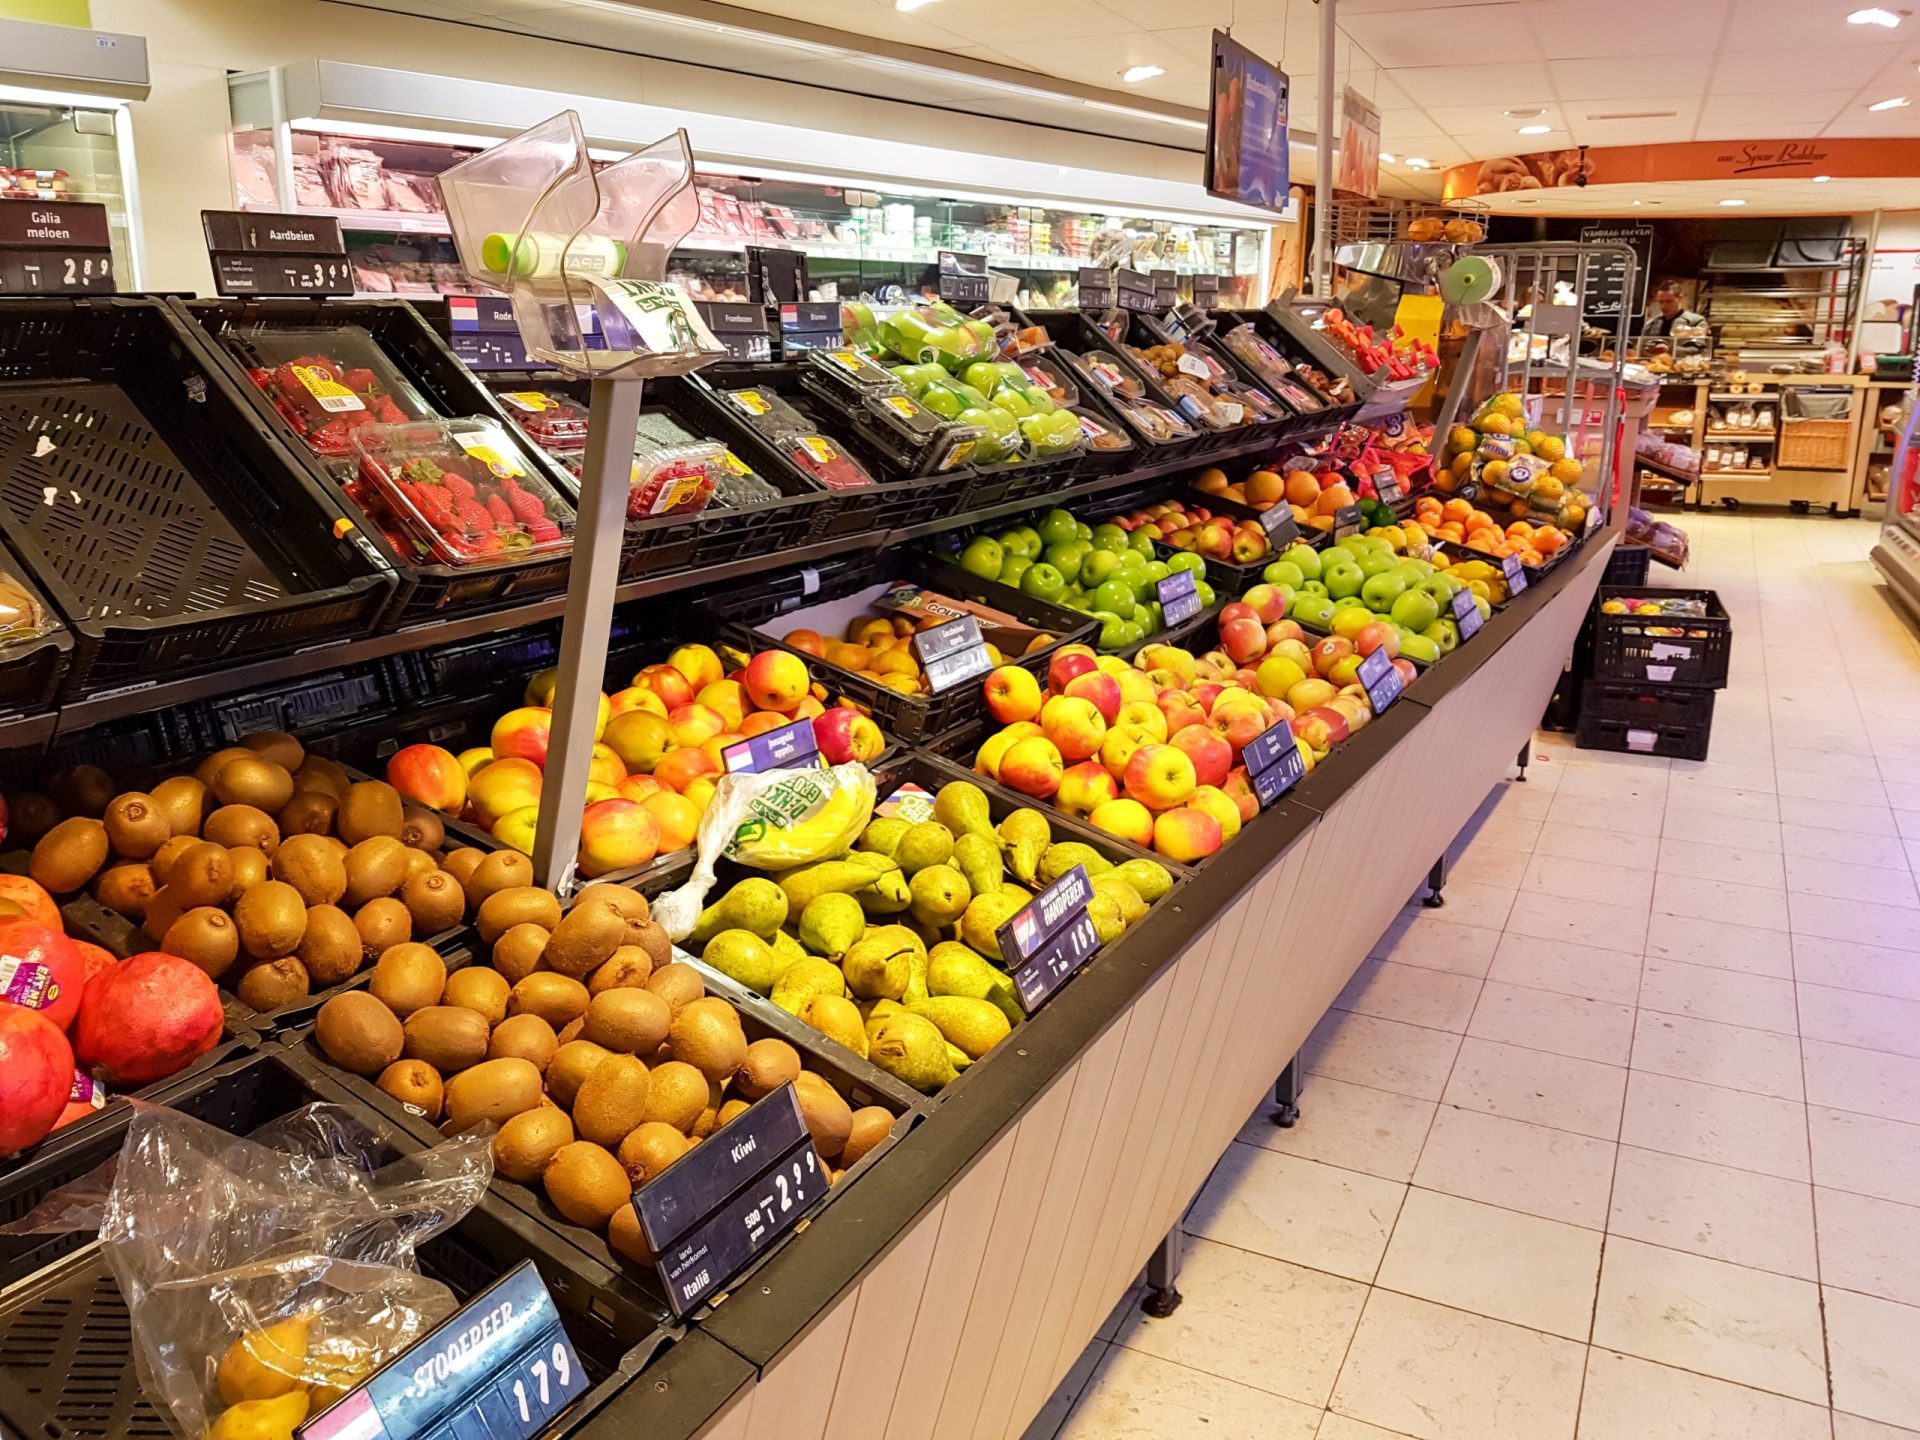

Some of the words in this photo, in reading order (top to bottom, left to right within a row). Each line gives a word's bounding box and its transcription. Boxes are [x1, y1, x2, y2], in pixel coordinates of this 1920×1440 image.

[31, 212, 61, 224] Galia
[26, 227, 70, 239] meloen
[270, 230, 315, 241] Aardbeien
[493, 311, 513, 320] Rode
[767, 730, 795, 750] Jonagold
[773, 743, 795, 759] appels
[751, 800, 788, 828] SPAR
[1044, 878, 1085, 926] HANDPEREN
[731, 1135, 757, 1163] Kiwi
[744, 1209, 761, 1229] 500
[750, 1225, 765, 1242] gram
[670, 1265, 682, 1279] van
[681, 1244, 708, 1274] herkomst
[678, 1245, 693, 1261] land
[683, 1269, 710, 1300] Italië
[512, 1342, 571, 1423] 179
